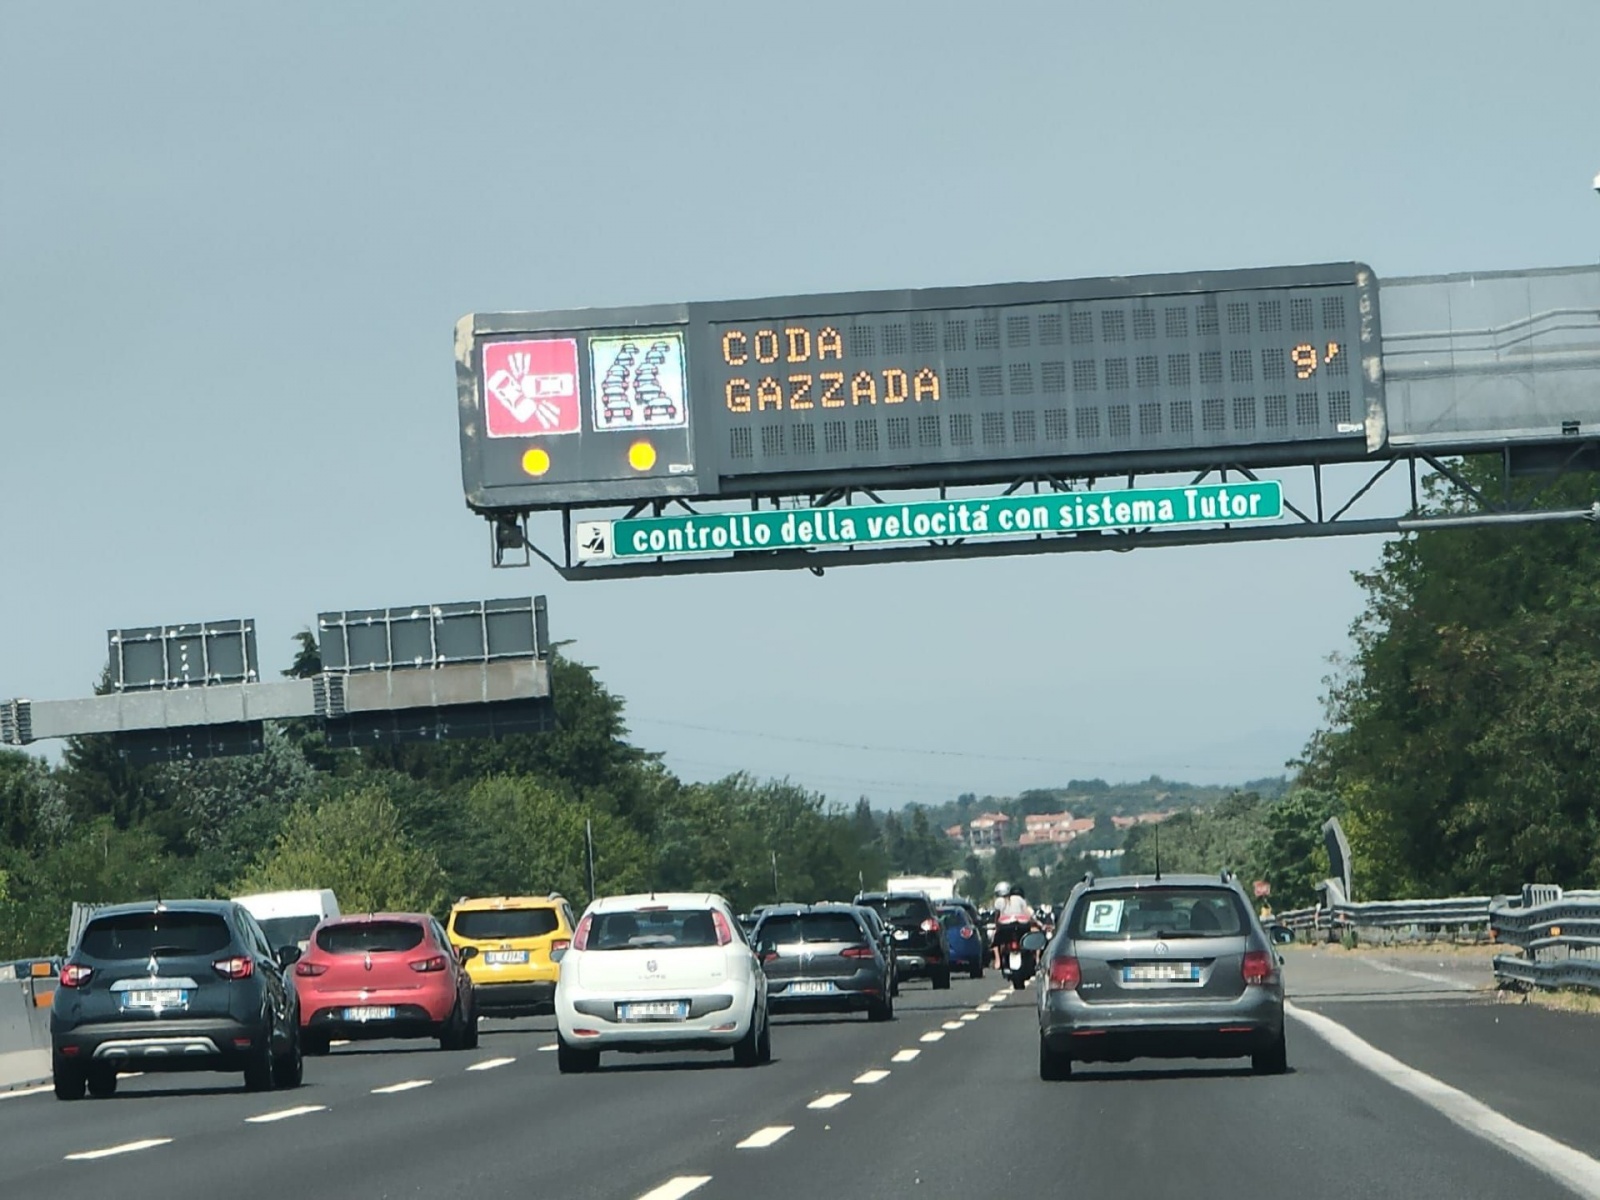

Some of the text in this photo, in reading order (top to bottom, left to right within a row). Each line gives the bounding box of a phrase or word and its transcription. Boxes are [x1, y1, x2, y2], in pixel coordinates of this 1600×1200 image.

[722, 326, 842, 366] CODA
[725, 367, 940, 412] GAZZADA
[632, 516, 772, 552] controllo
[781, 510, 857, 544] della
[997, 505, 1050, 531] con
[1059, 495, 1175, 527] sistema
[1184, 488, 1262, 520] Tutor
[1093, 904, 1113, 925] P
